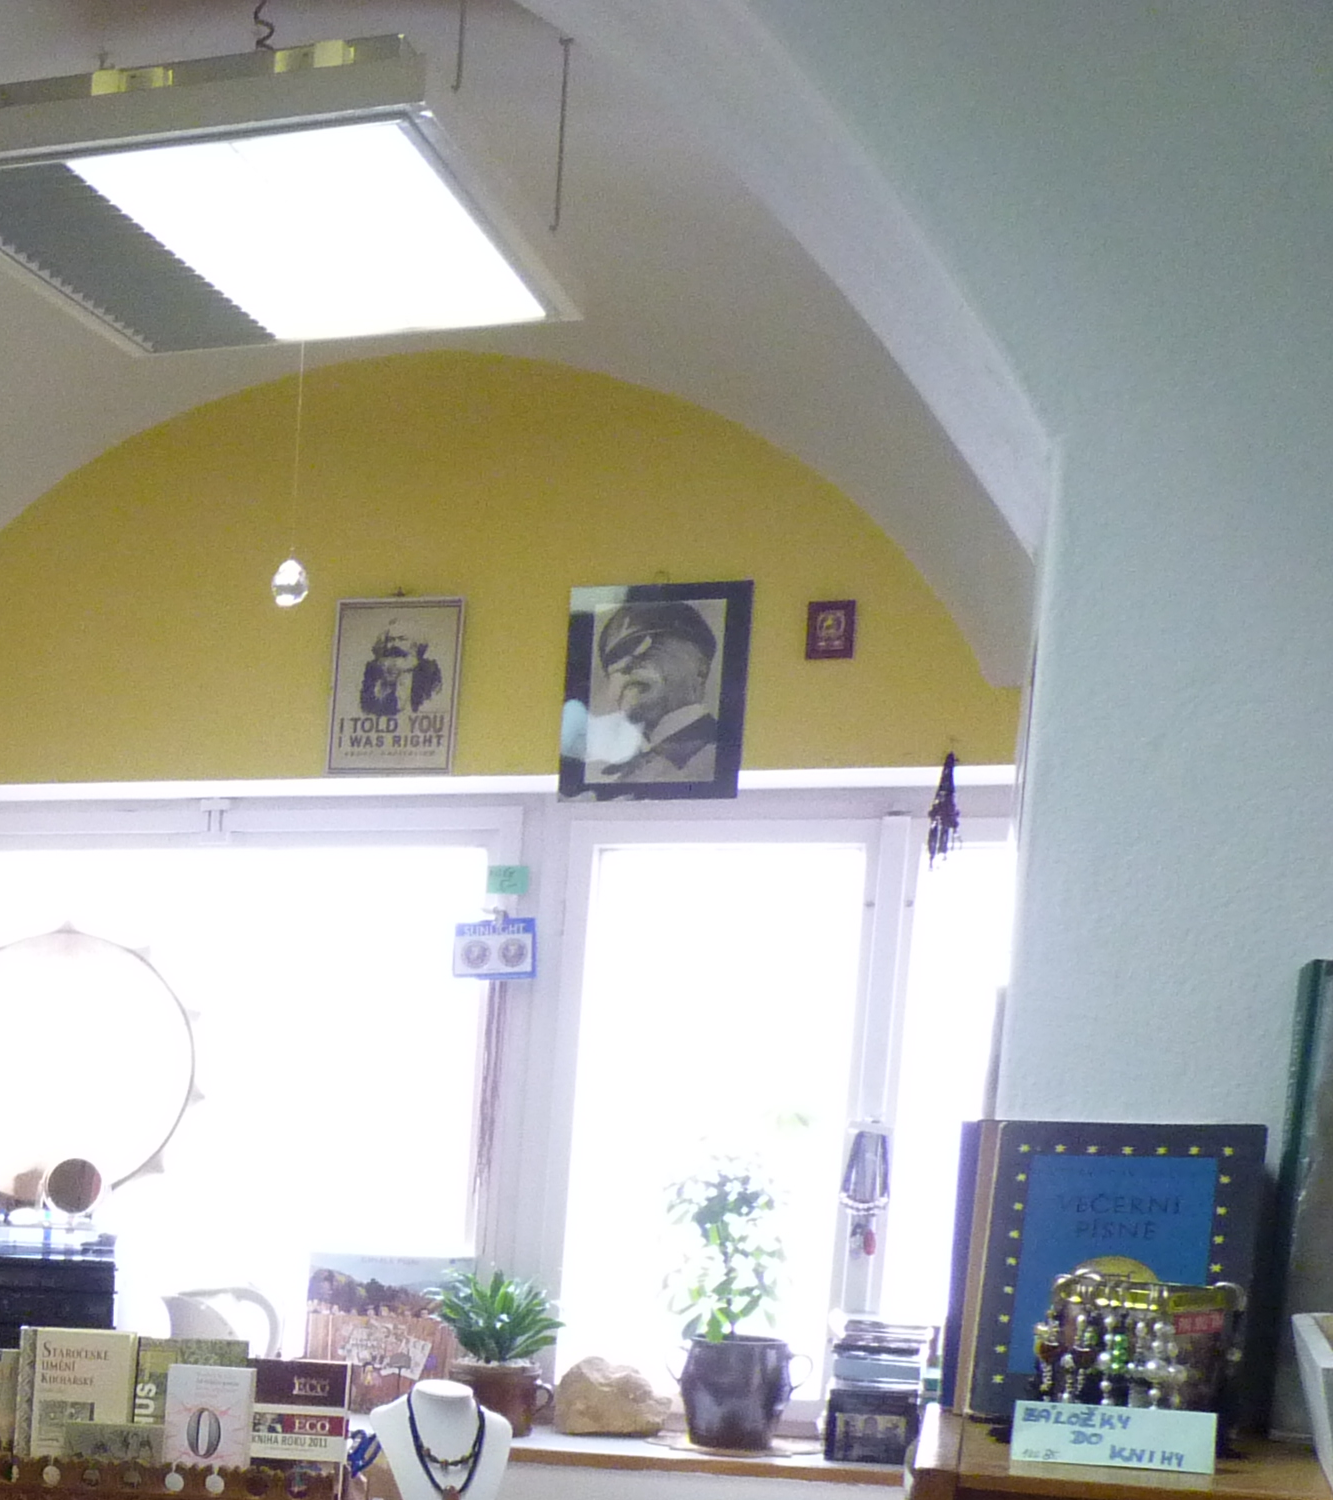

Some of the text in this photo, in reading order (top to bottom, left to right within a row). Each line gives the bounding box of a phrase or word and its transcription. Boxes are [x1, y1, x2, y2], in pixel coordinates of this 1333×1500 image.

[349, 716, 399, 735] TOLD
[407, 714, 445, 734] YOU
[349, 735, 385, 748] WAS
[391, 734, 445, 748] RIGHT
[40, 1341, 110, 1362] STAROČESKÉ
[40, 1360, 76, 1373] UMĚNÍ
[292, 1377, 330, 1396] ECO
[1022, 1405, 1132, 1427] ZÁLOŽKY
[293, 1420, 330, 1434] ECO
[281, 1435, 307, 1447] ROKU
[308, 1437, 329, 1449] 2011
[1069, 1429, 1103, 1446] DO
[1109, 1445, 1185, 1466] KNIHY
